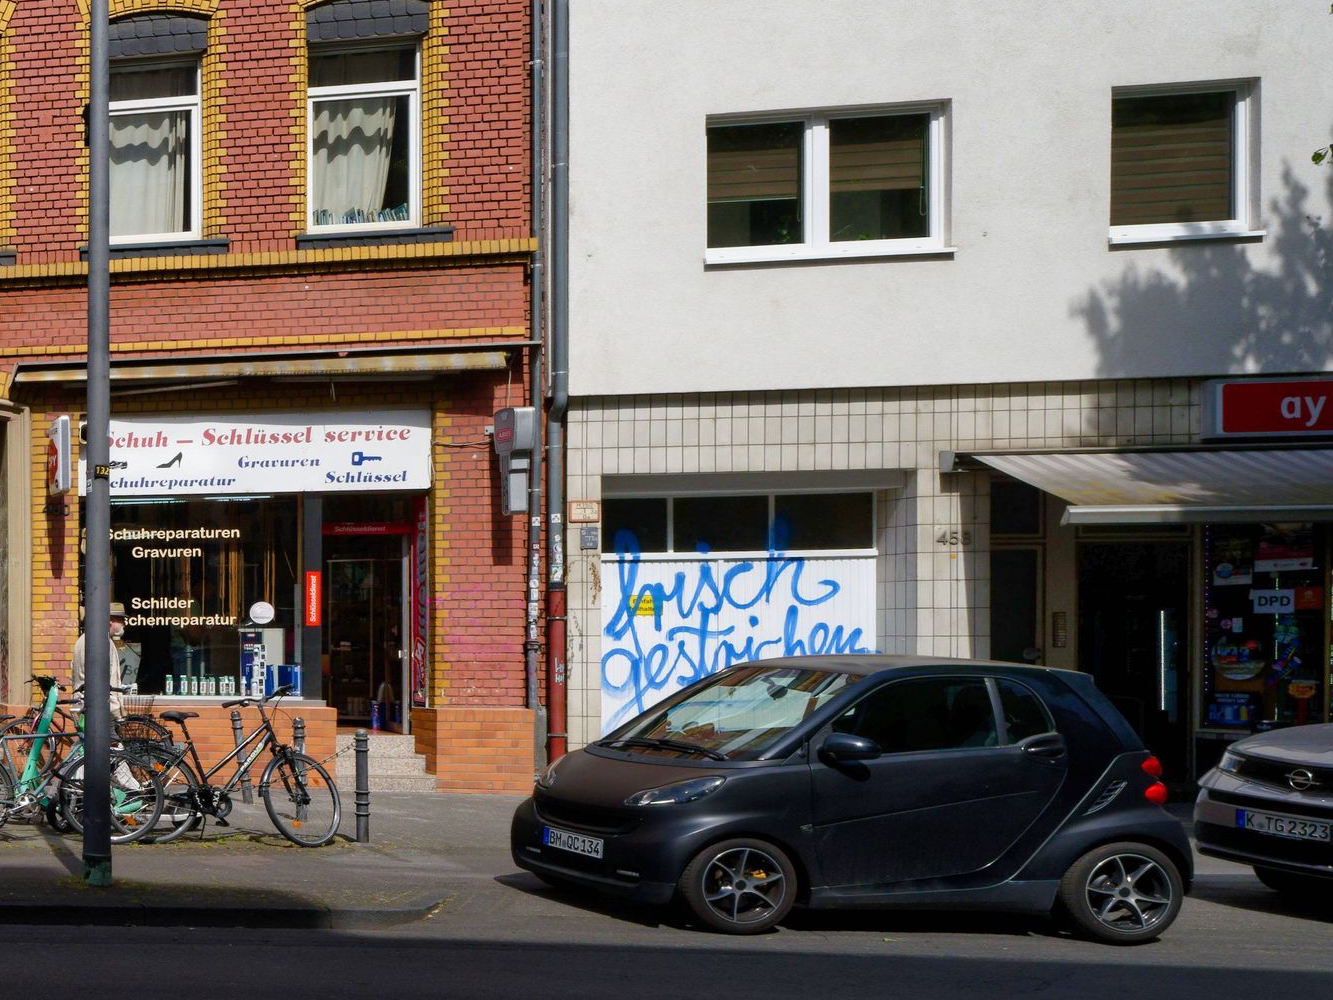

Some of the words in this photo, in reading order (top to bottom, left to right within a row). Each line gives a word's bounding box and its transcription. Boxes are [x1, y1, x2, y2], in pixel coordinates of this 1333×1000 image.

[202, 426, 312, 446] Schlüssel
[324, 426, 412, 442] service
[238, 456, 320, 468] Gravuren
[110, 476, 236, 490] chuhreparatur
[325, 470, 408, 484] Schlüssel
[132, 546, 202, 558] Gravuren
[132, 597, 194, 609] Schilder
[309, 576, 317, 622] Schlüsseldienst
[1257, 595, 1291, 608] DPD
[124, 614, 237, 628] schenreparatur
[1246, 812, 1256, 828] K
[1265, 816, 1284, 832] TG
[1288, 820, 1329, 840] 2323
[550, 830, 562, 845] BM
